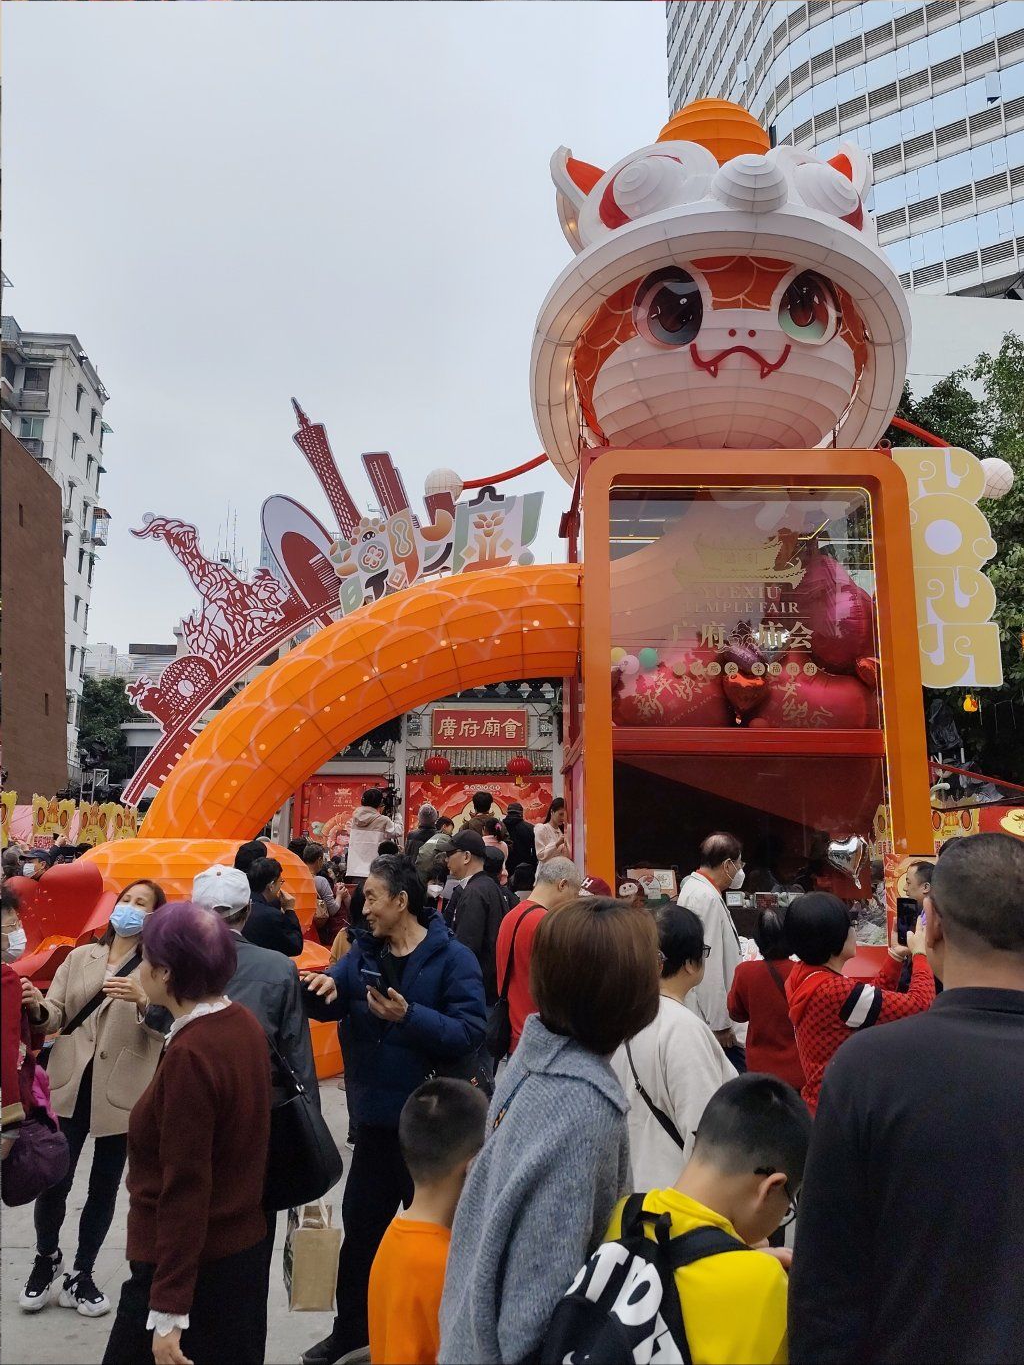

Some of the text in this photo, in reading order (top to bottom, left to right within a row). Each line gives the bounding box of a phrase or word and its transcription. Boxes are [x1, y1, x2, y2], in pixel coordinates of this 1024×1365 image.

[702, 586, 782, 599] YUEXIU
[759, 602, 800, 614] FAIR
[672, 621, 814, 649] 广府 庙会
[437, 716, 523, 740] 廣府廟會
